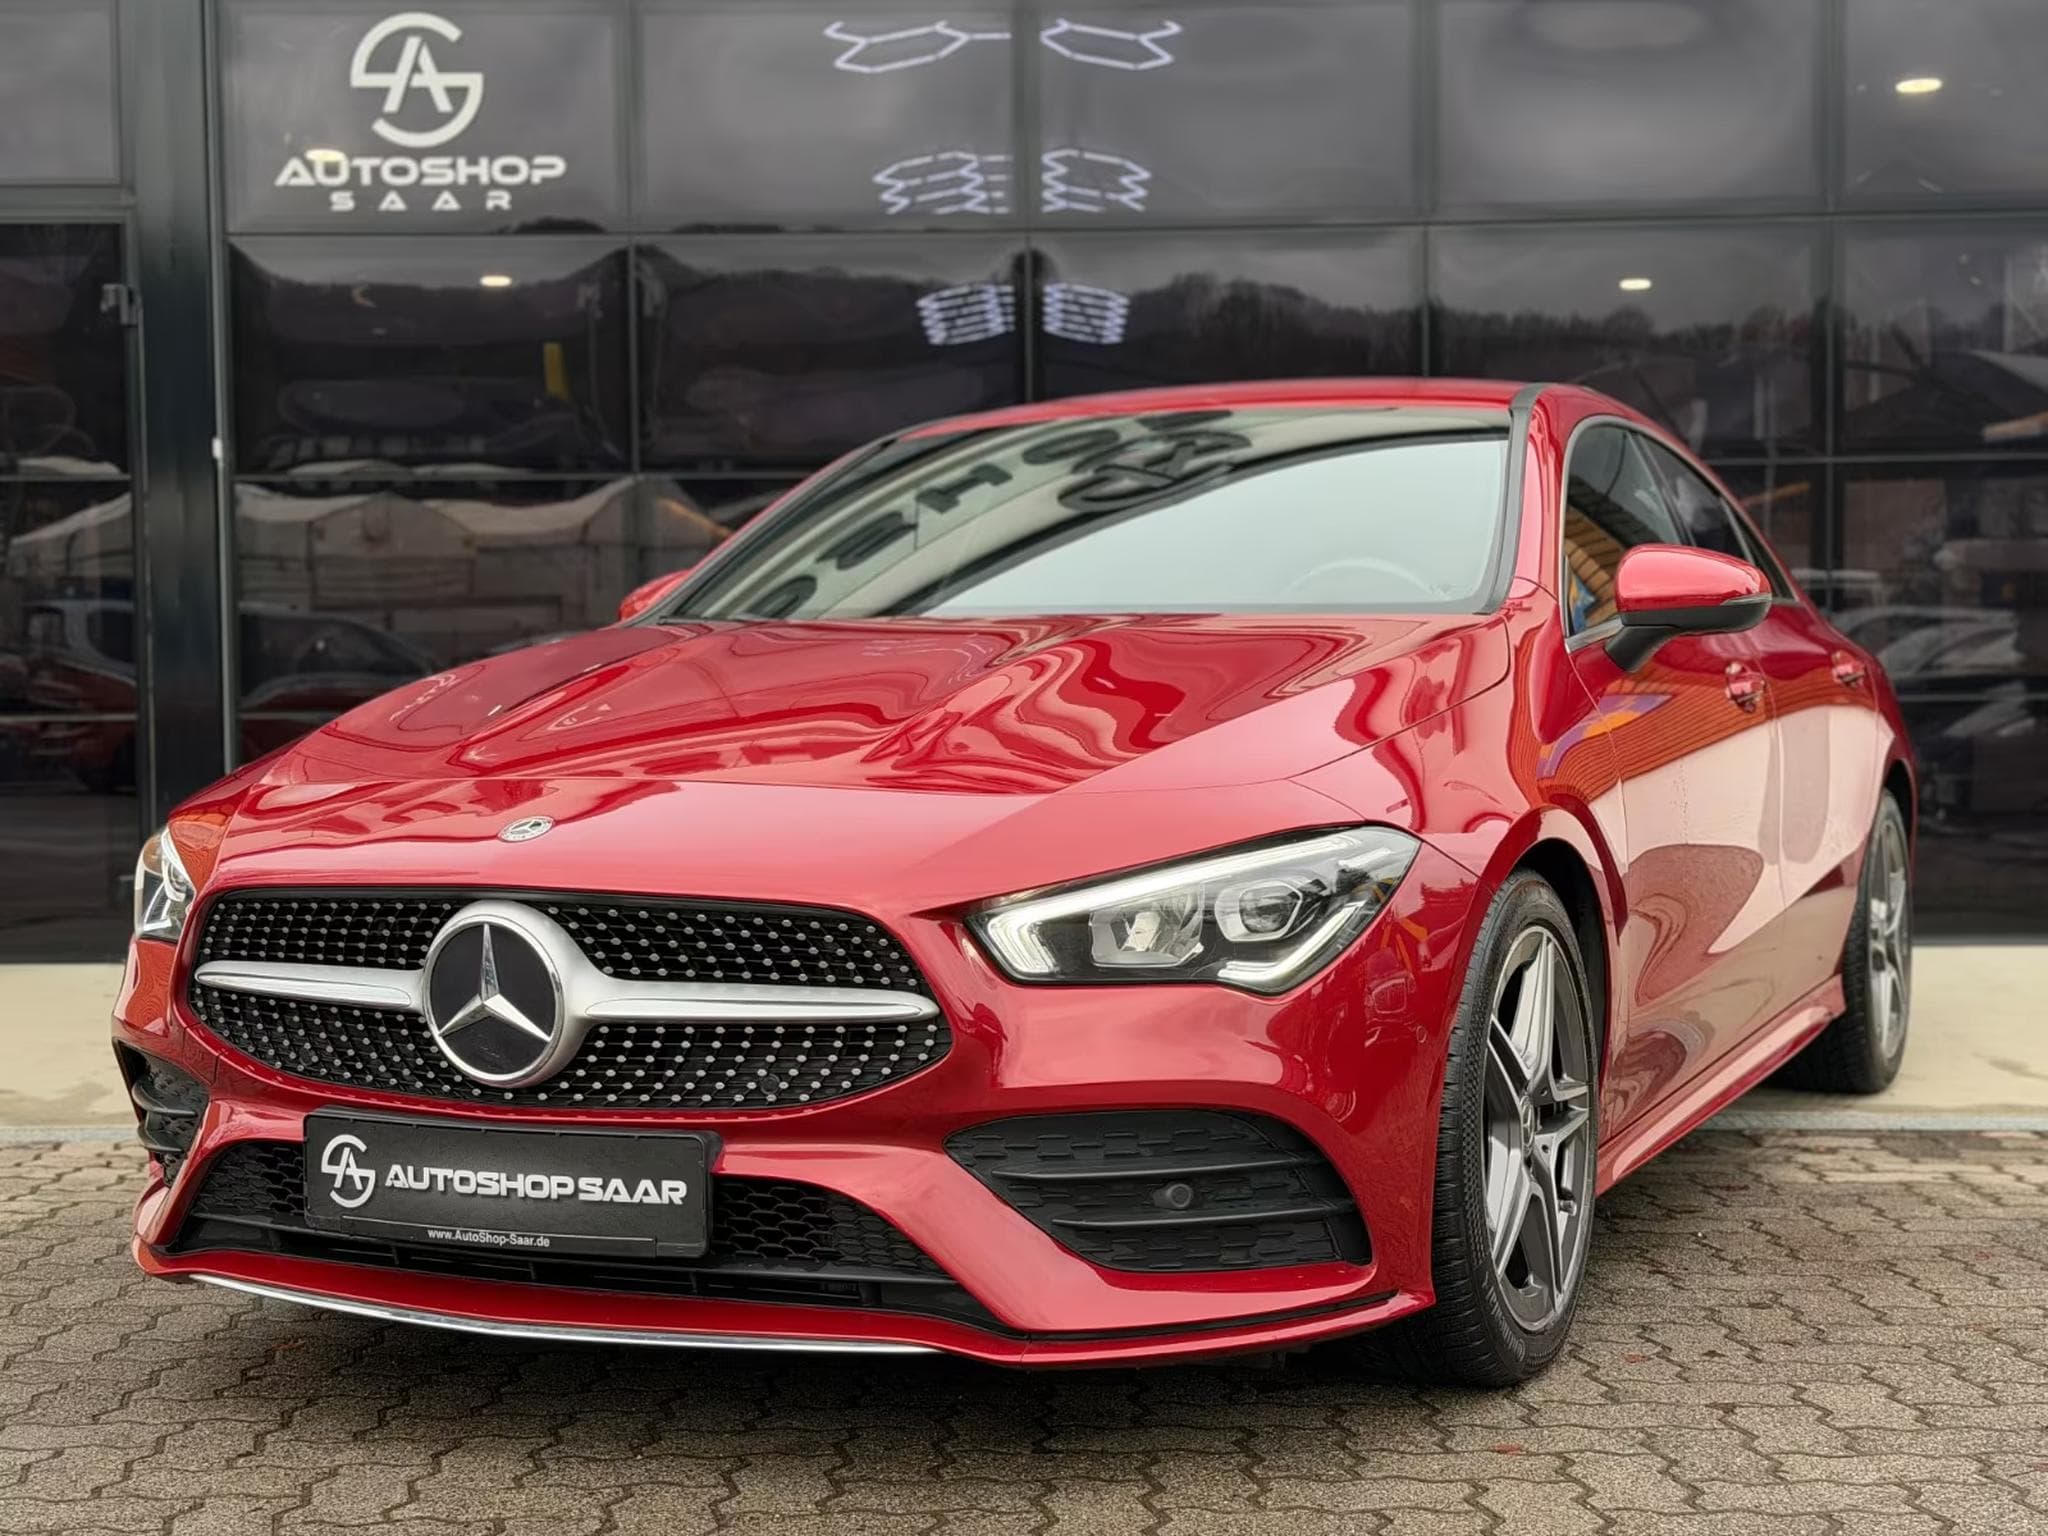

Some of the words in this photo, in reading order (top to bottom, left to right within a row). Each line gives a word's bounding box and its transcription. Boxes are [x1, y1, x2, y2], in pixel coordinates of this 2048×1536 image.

[274, 154, 566, 188] AUTOSHOP
[329, 190, 512, 211] SAAR
[427, 1228, 551, 1248] www.AutoShop-Saar.de
